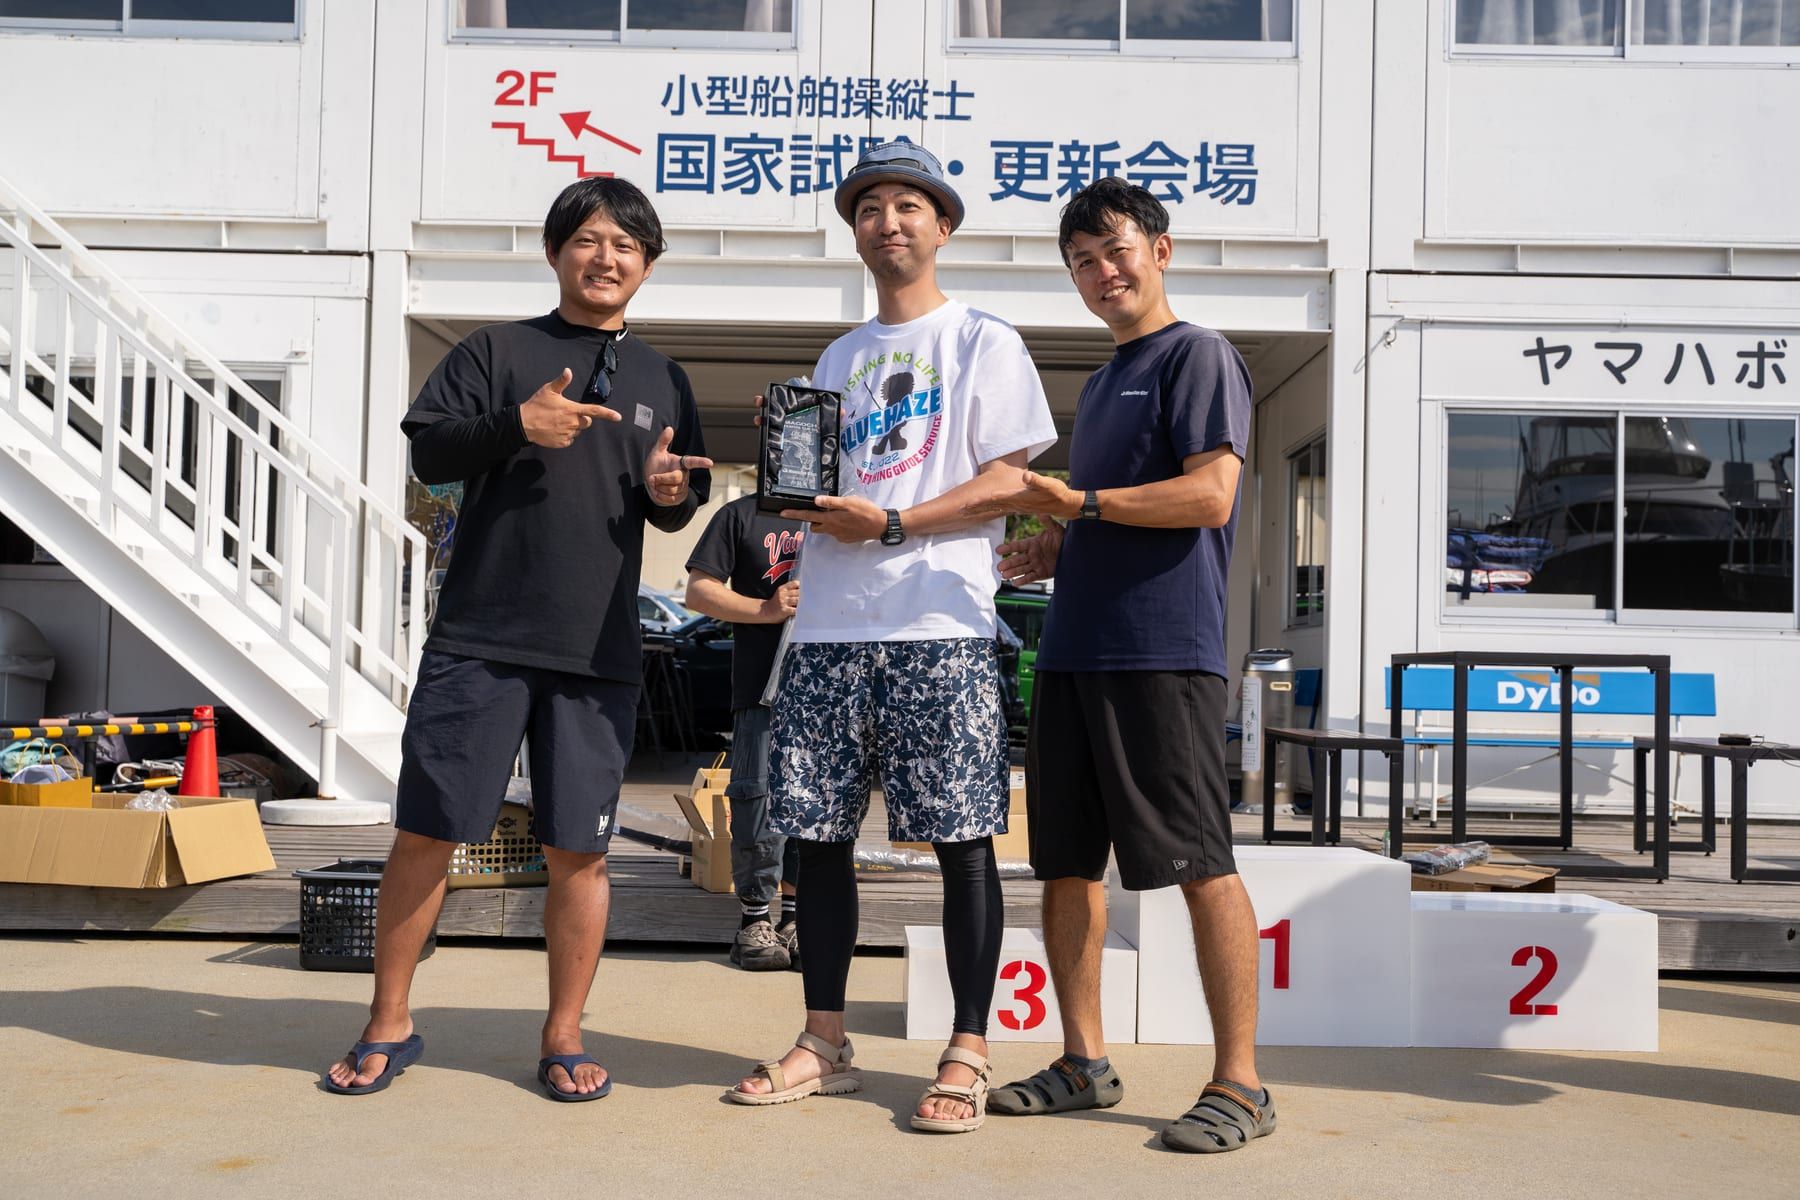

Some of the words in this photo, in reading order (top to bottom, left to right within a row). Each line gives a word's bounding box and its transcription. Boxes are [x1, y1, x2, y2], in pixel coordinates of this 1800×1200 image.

[494, 70, 556, 107] 2F
[661, 73, 976, 122] 小型船舶操縦士
[655, 132, 1259, 207] 国家試・更新会場
[841, 353, 887, 402] FISHING
[892, 351, 913, 364] NO
[914, 357, 941, 387] LIFE
[1523, 336, 1788, 389] ヤマハボ
[892, 453, 923, 476] GUIDE
[918, 414, 942, 458] SERVICE
[1259, 919, 1291, 990] 1
[1508, 945, 1559, 1016] 2
[997, 960, 1047, 1031] 3
